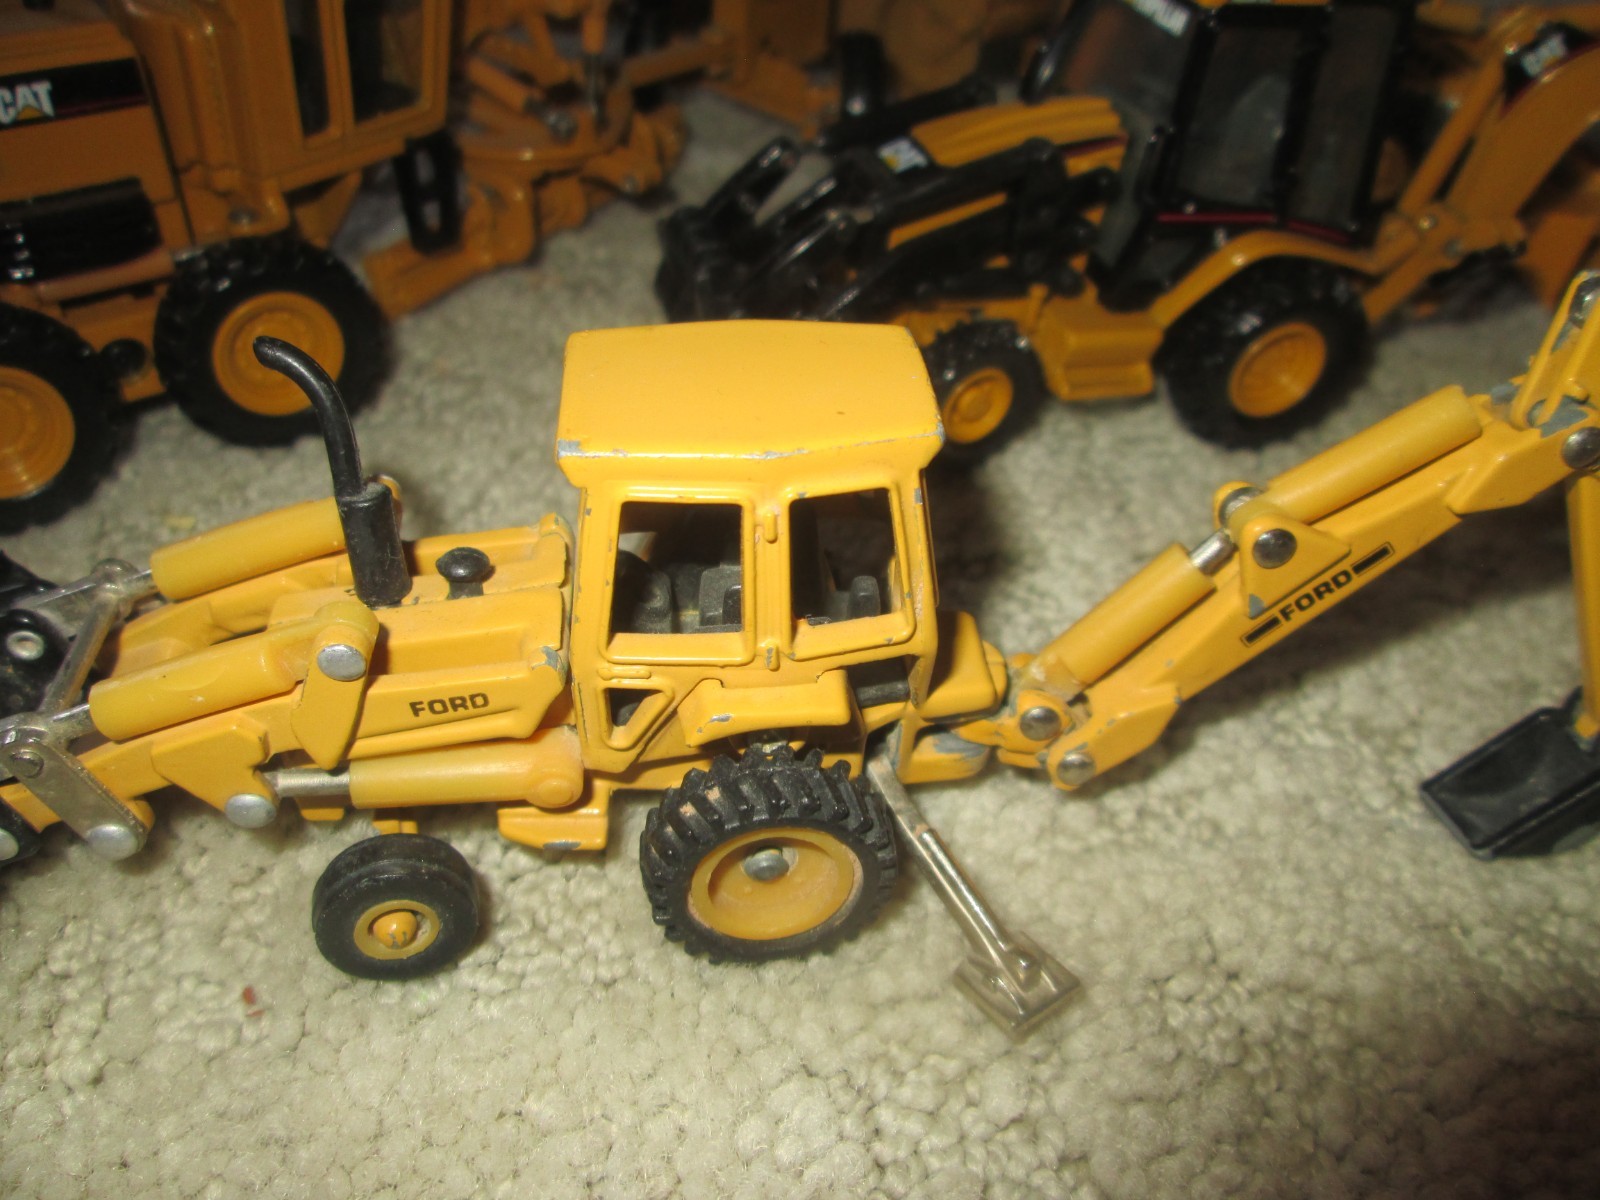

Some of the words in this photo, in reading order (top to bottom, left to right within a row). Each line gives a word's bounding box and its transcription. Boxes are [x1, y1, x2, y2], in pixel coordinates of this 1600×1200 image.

[0, 80, 55, 124] CAT
[1278, 569, 1353, 622] FORD
[409, 692, 489, 717] FORD
